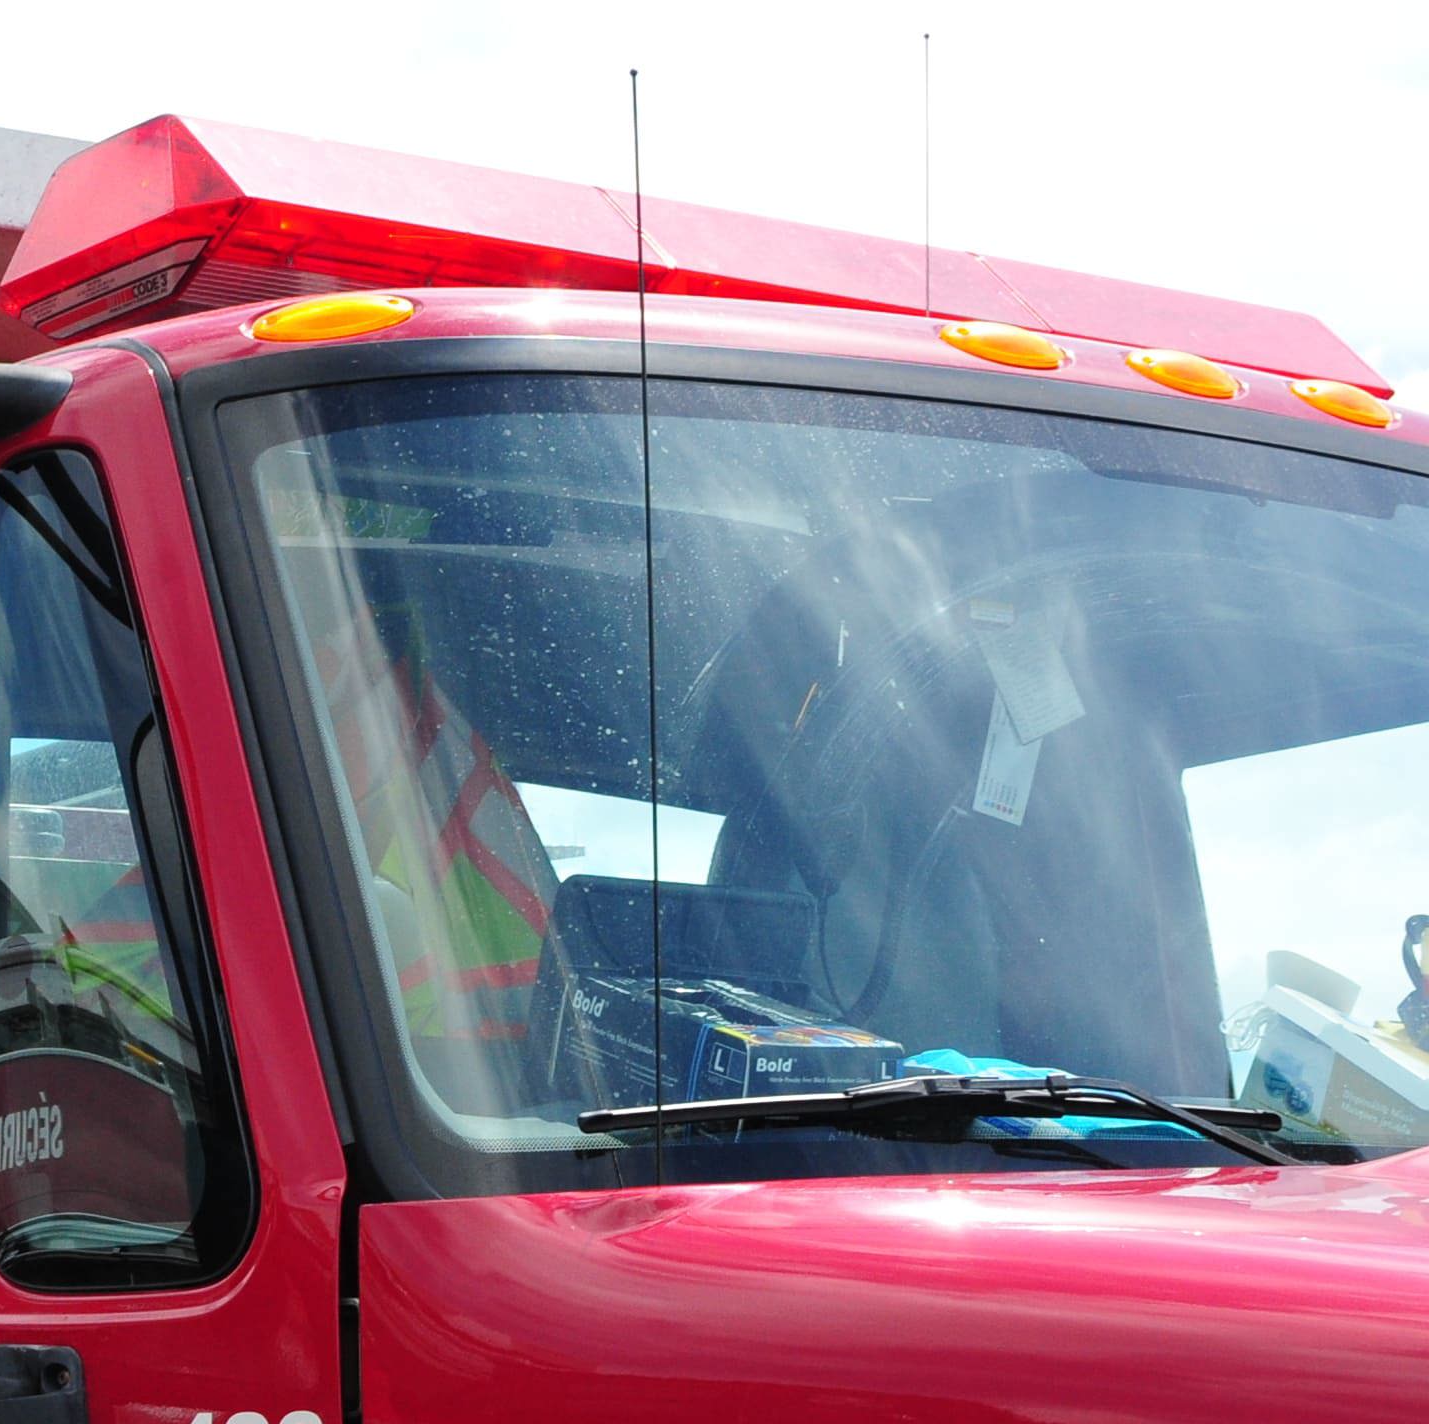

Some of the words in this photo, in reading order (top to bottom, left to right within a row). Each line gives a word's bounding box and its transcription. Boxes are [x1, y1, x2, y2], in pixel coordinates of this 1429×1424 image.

[132, 276, 160, 298] CODE
[160, 271, 168, 287] 3
[572, 989, 604, 1018] Bold
[713, 1048, 725, 1073] L
[755, 1057, 793, 1073] Bold
[881, 1062, 893, 1079] L
